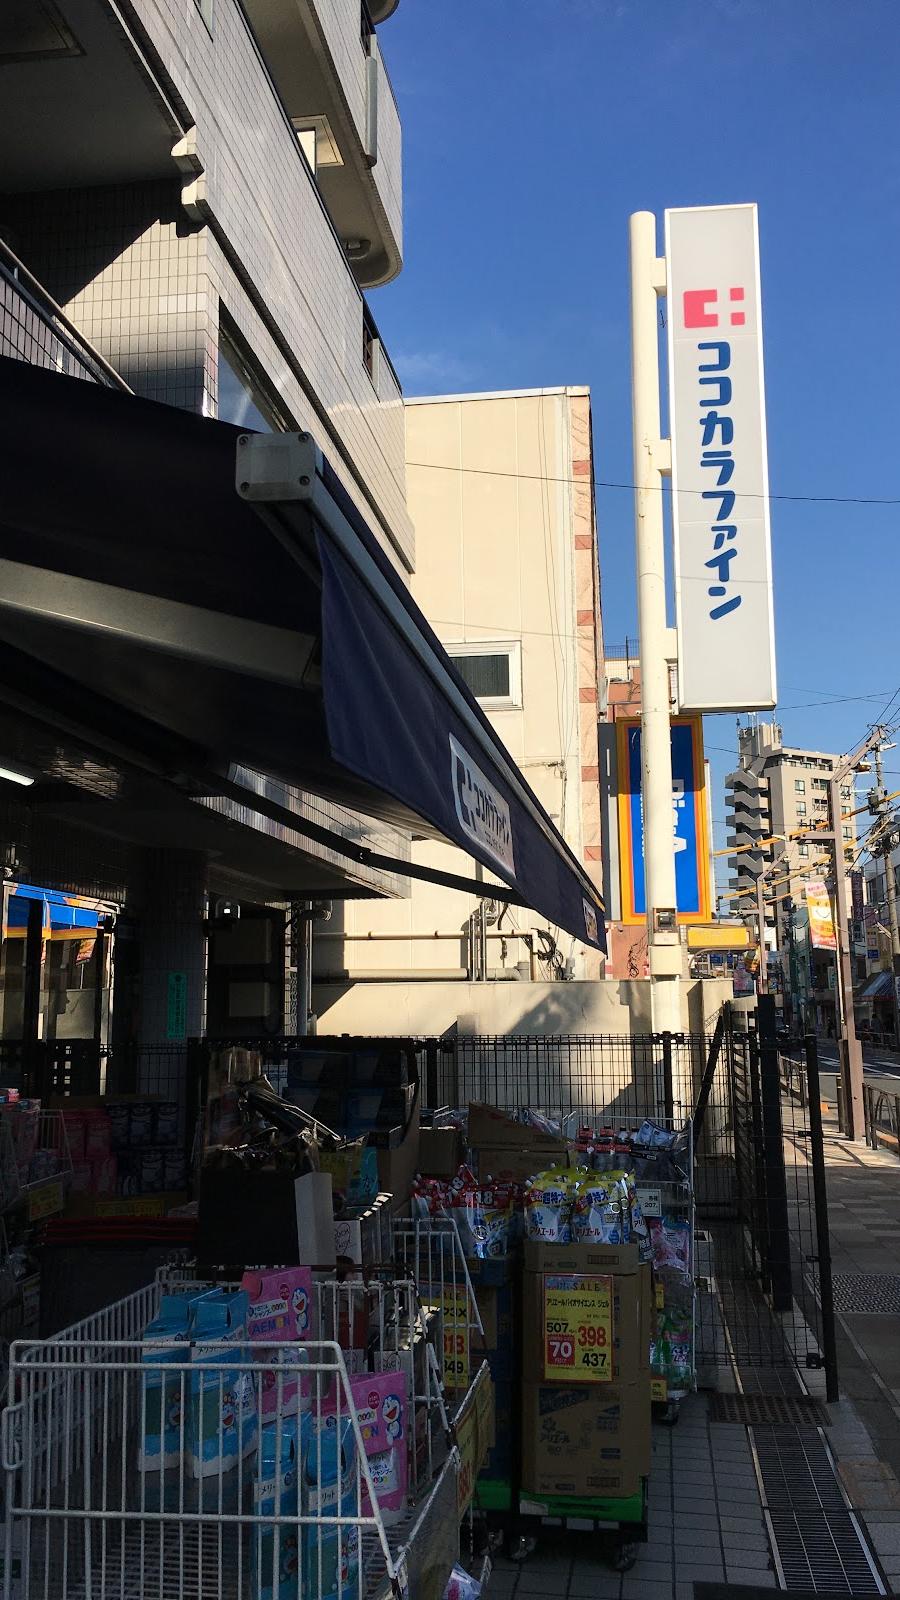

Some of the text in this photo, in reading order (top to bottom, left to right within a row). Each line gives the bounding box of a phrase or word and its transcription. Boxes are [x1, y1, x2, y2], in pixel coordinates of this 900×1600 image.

[698, 341, 742, 621] ココカラファイン
[543, 1191, 567, 1205] 超特大
[529, 1227, 556, 1237] アリエール
[576, 1227, 601, 1237] アリエール
[573, 1282, 600, 1291] SALE
[546, 1322, 569, 1333] 507
[578, 1326, 607, 1347] 398
[549, 1341, 573, 1359] 70
[582, 1352, 607, 1367] 437
